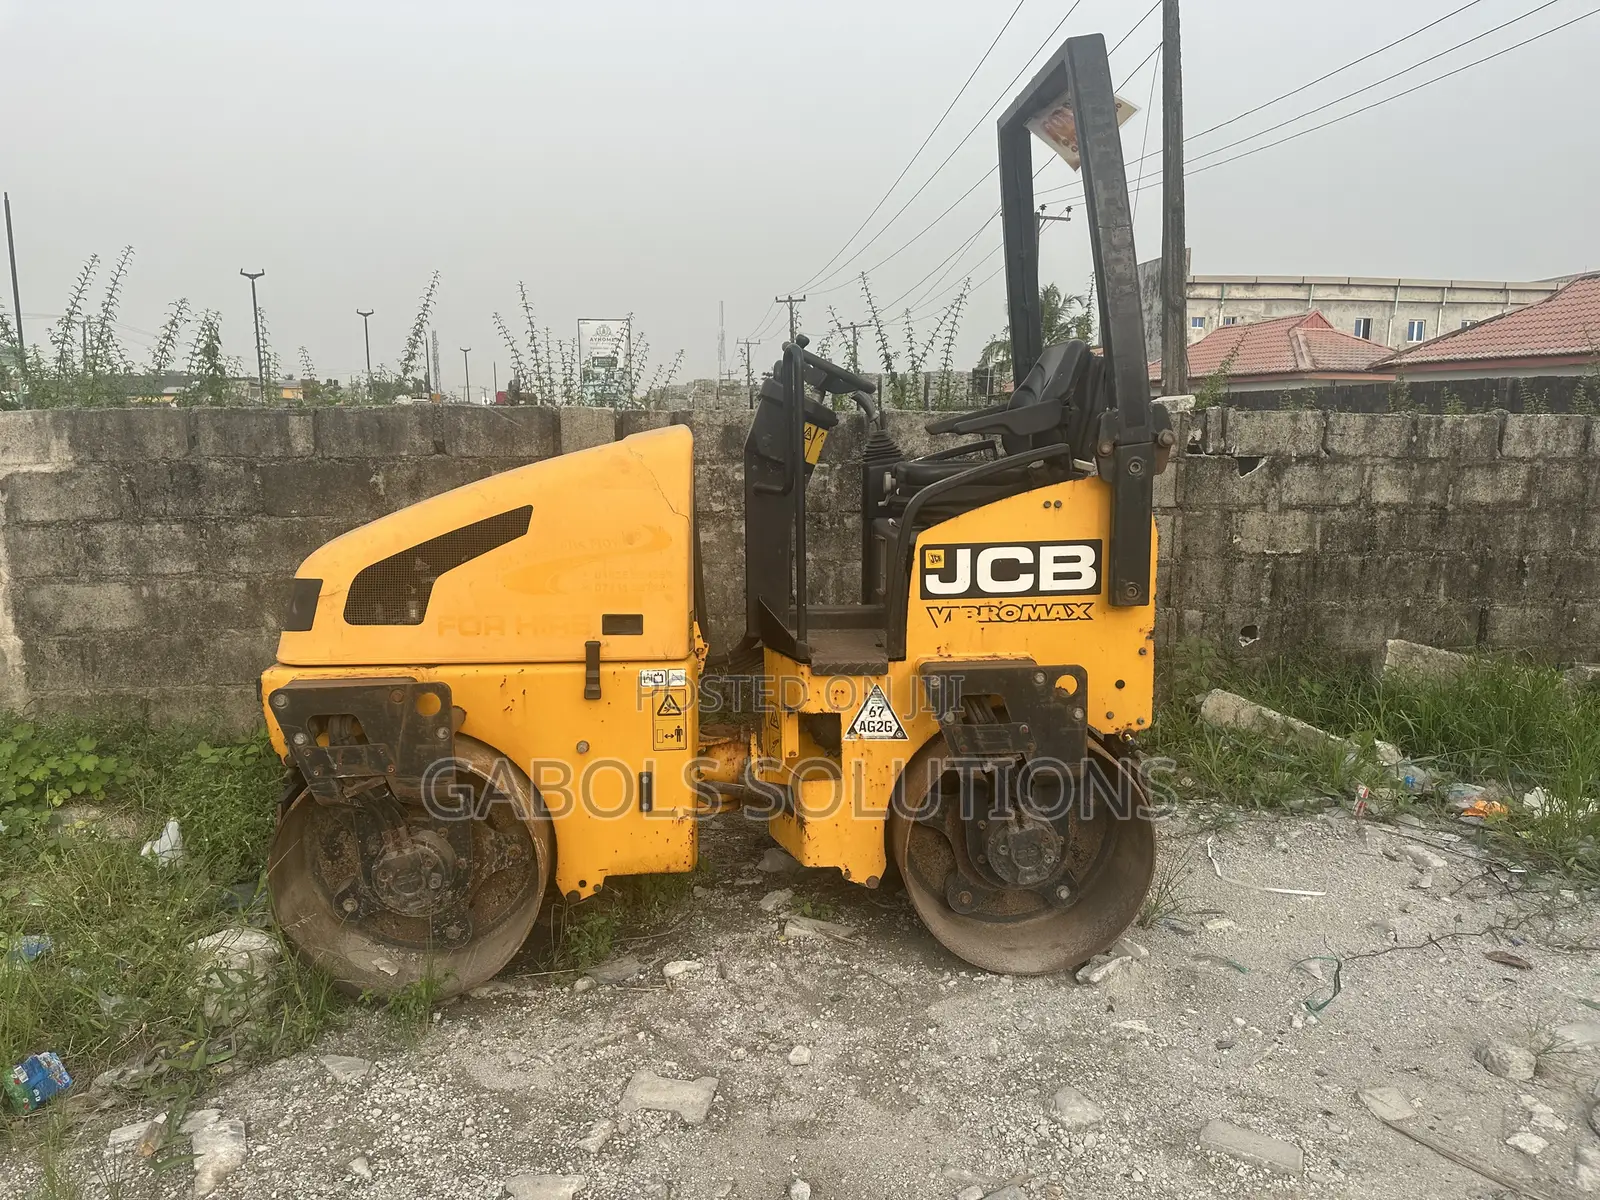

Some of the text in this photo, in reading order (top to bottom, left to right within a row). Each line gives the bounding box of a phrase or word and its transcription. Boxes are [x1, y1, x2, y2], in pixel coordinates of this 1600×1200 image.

[925, 545, 1097, 595] JCB
[868, 706, 885, 718] 67
[859, 720, 893, 733] AG2G
